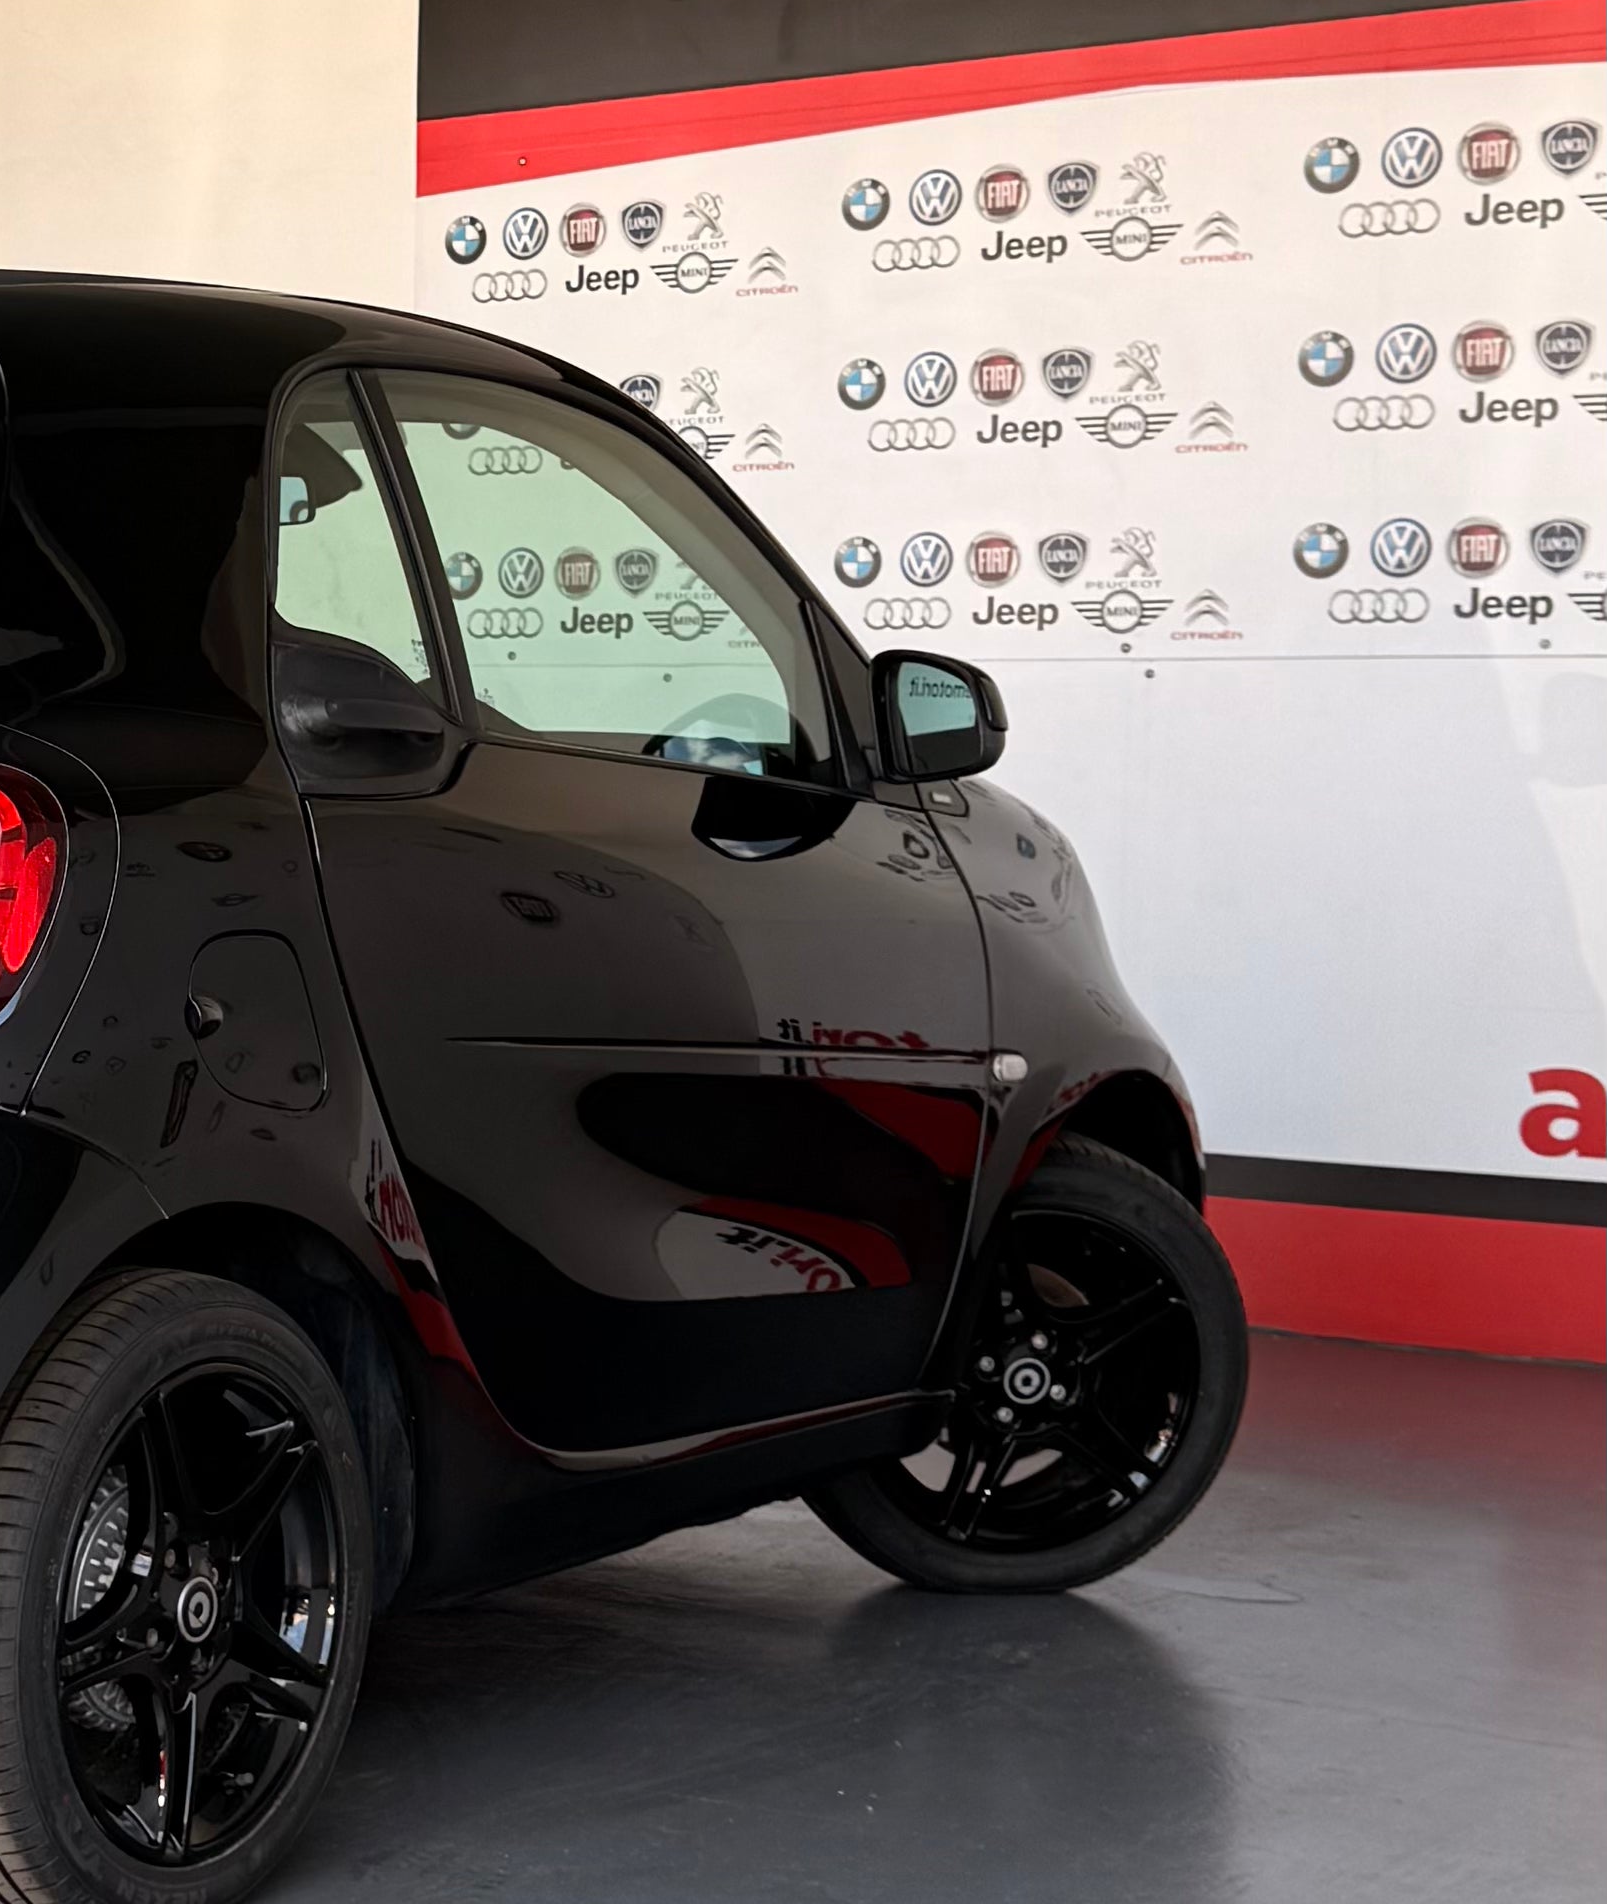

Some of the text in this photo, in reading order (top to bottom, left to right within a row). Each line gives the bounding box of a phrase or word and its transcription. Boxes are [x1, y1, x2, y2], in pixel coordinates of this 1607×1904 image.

[1471, 138, 1510, 171] FIAT
[987, 179, 1020, 209] FIAT
[1464, 193, 1565, 229] Jeep
[570, 217, 598, 244] FIAT
[1115, 233, 1148, 245] MINI
[981, 230, 1068, 264] Jeep
[565, 264, 640, 295] Jeep
[680, 268, 708, 278] MINI
[1465, 337, 1504, 368] FIAT
[982, 364, 1015, 392] FIAT
[666, 416, 724, 426] EUGEOT
[1459, 390, 1559, 428] Jeep
[976, 414, 1063, 448] Jeep
[1110, 421, 1142, 432] MINI
[978, 546, 1011, 574] FIAT
[1460, 534, 1499, 564] FIAT
[564, 561, 593, 586] FIAT
[972, 596, 1060, 631] Jeep
[1105, 606, 1139, 617] MINI
[1453, 587, 1554, 625] Jeep
[561, 606, 634, 640] Jeep
[1519, 1068, 1607, 1158] a
